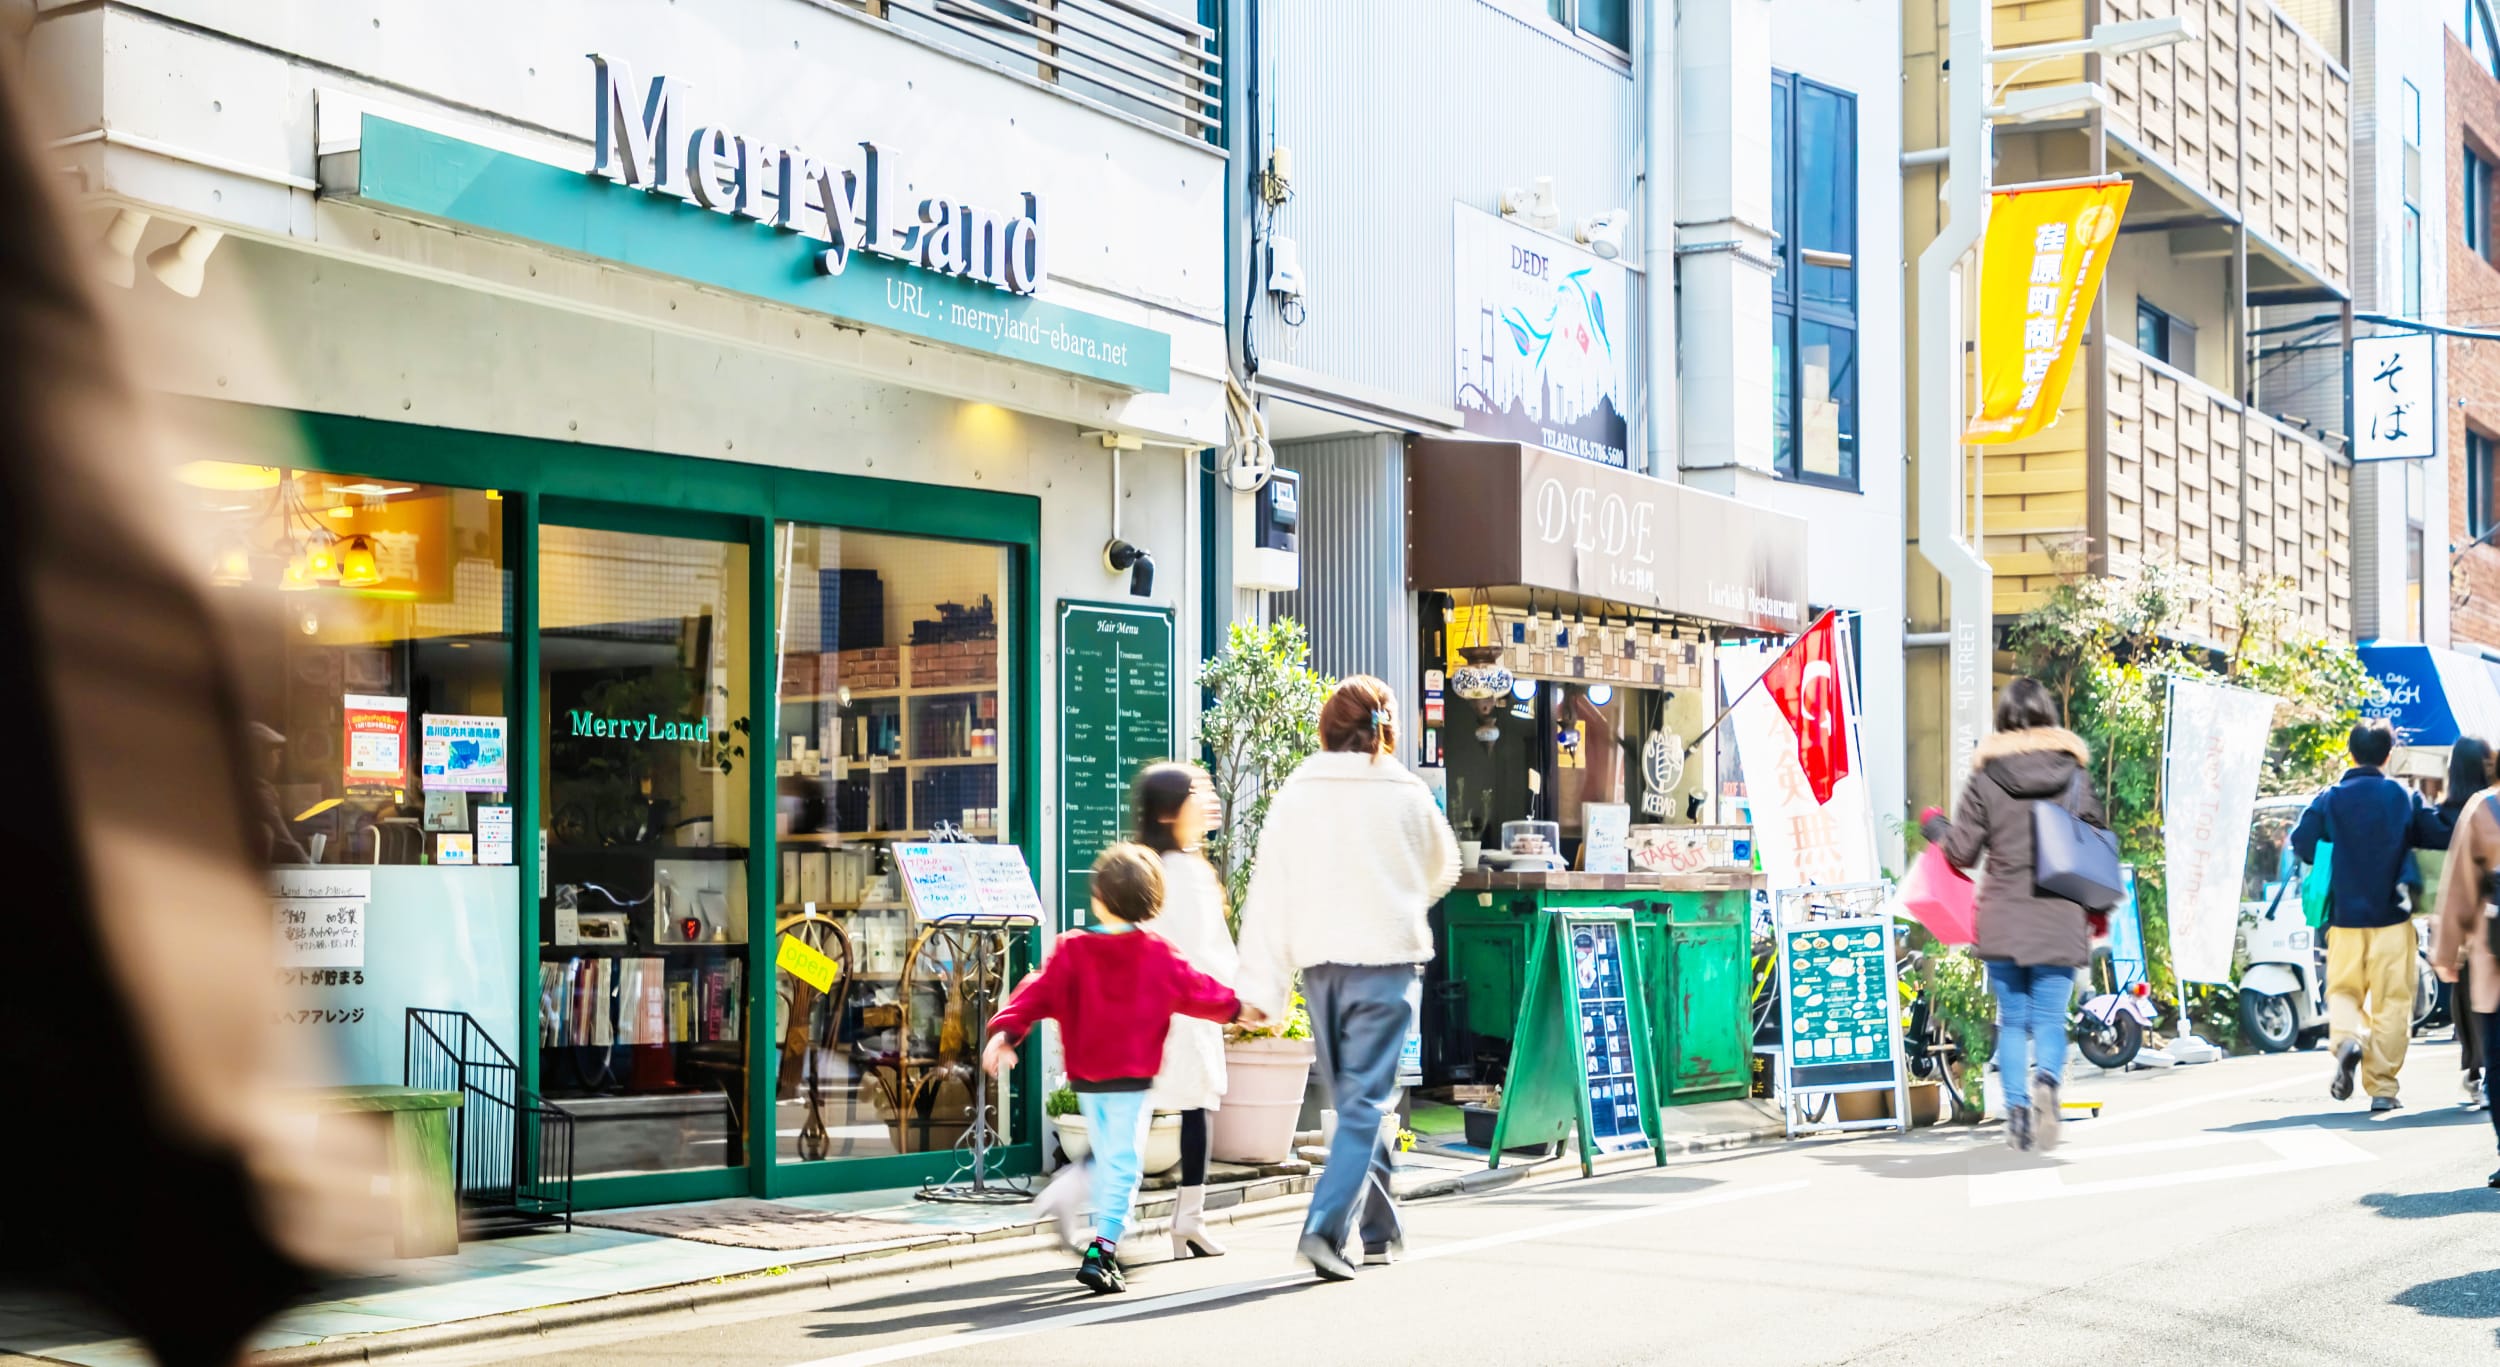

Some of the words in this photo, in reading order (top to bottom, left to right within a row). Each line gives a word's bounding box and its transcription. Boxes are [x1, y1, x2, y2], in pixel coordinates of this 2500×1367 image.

[585, 52, 1049, 295] MerryLand
[1511, 244, 1549, 282] DEDE
[886, 278, 931, 320] URL
[950, 303, 1129, 369] merryland-ebara.net
[2371, 353, 2415, 441] そば
[1541, 427, 1579, 456] TEL&FAX
[1537, 478, 1656, 565] DEDE
[1705, 580, 1746, 611] Turkish
[1747, 587, 1798, 620] Restaurant
[1096, 619, 1116, 633] Hair
[1116, 621, 1140, 636] Menu
[1957, 619, 1976, 687] STREET
[569, 709, 711, 743] MerryLand
[1065, 705, 1081, 715] Color
[426, 725, 500, 739] 品川区内共通商品券
[1641, 792, 1678, 818] KEBAB
[1639, 840, 1680, 867] TAKE
[1670, 847, 1707, 872] OUT
[275, 969, 365, 987] ントが貯まる
